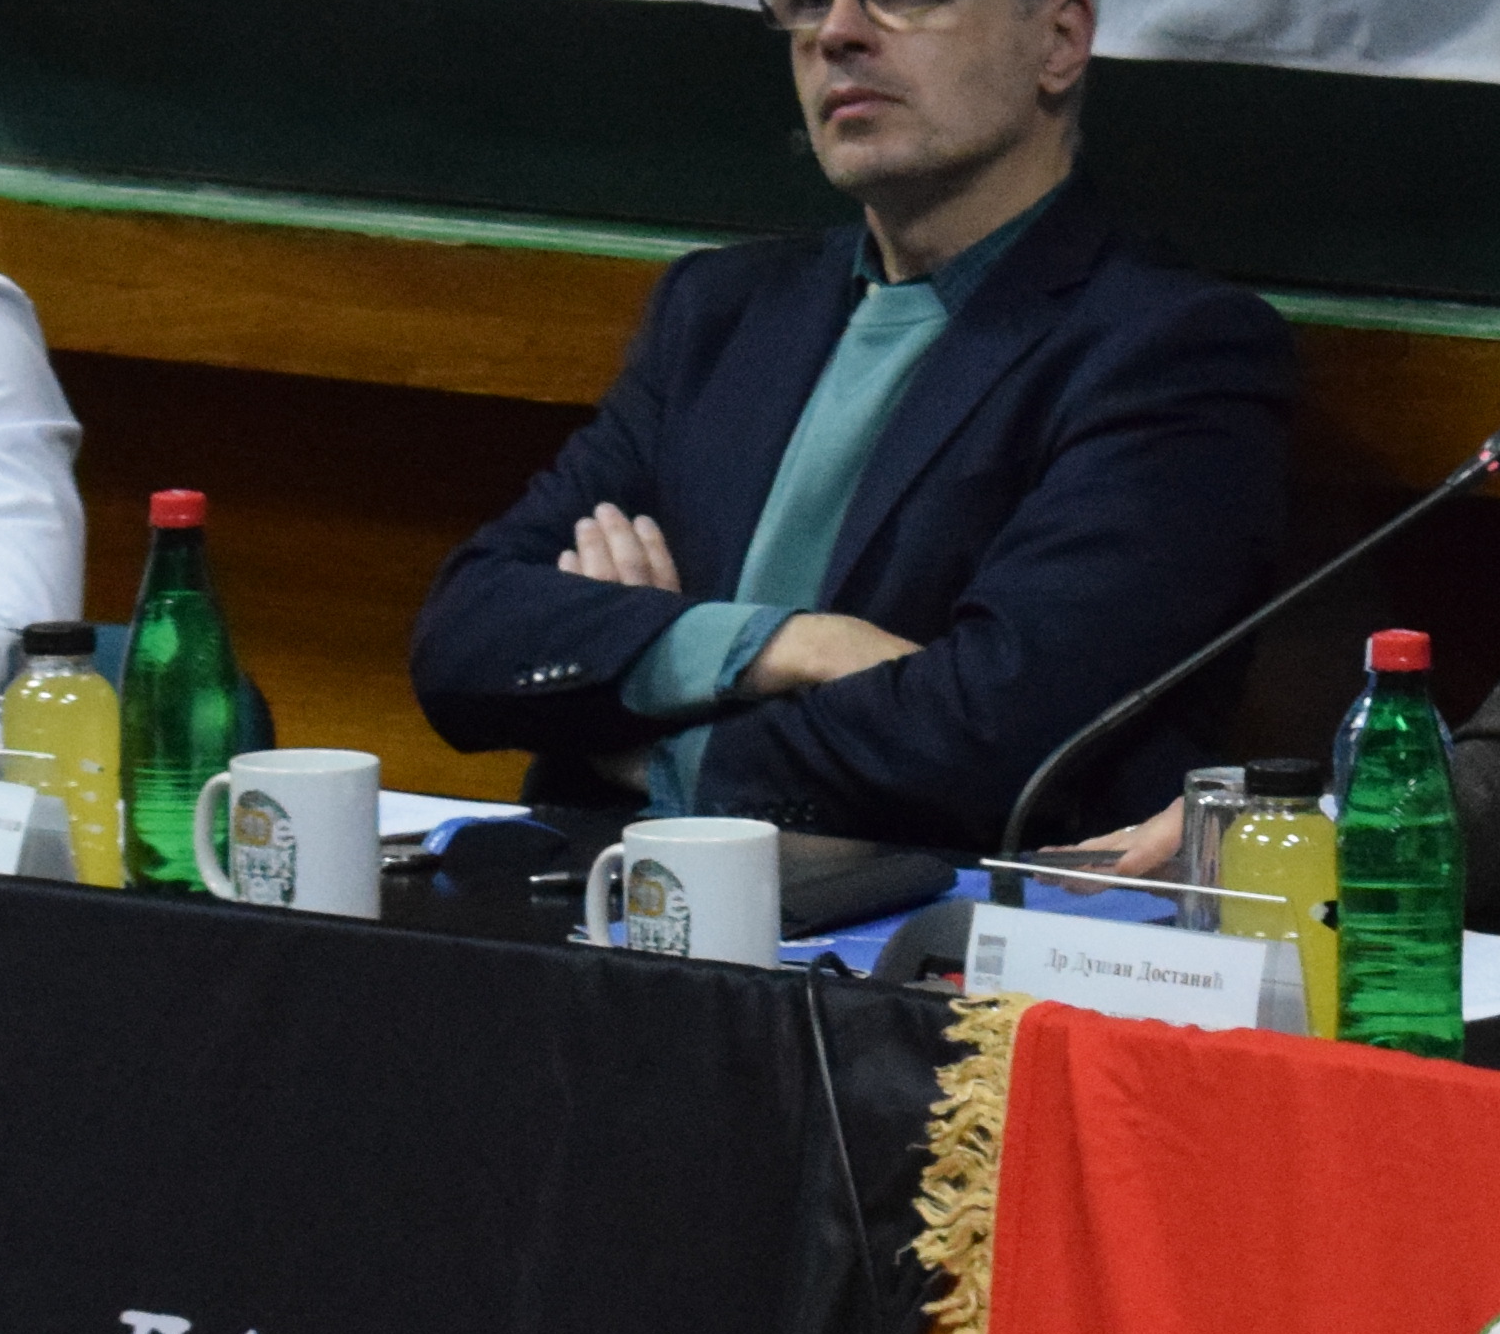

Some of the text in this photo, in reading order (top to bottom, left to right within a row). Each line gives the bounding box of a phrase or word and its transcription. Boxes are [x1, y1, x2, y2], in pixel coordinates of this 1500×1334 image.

[1044, 947, 1225, 991] Др Душан Достанић
